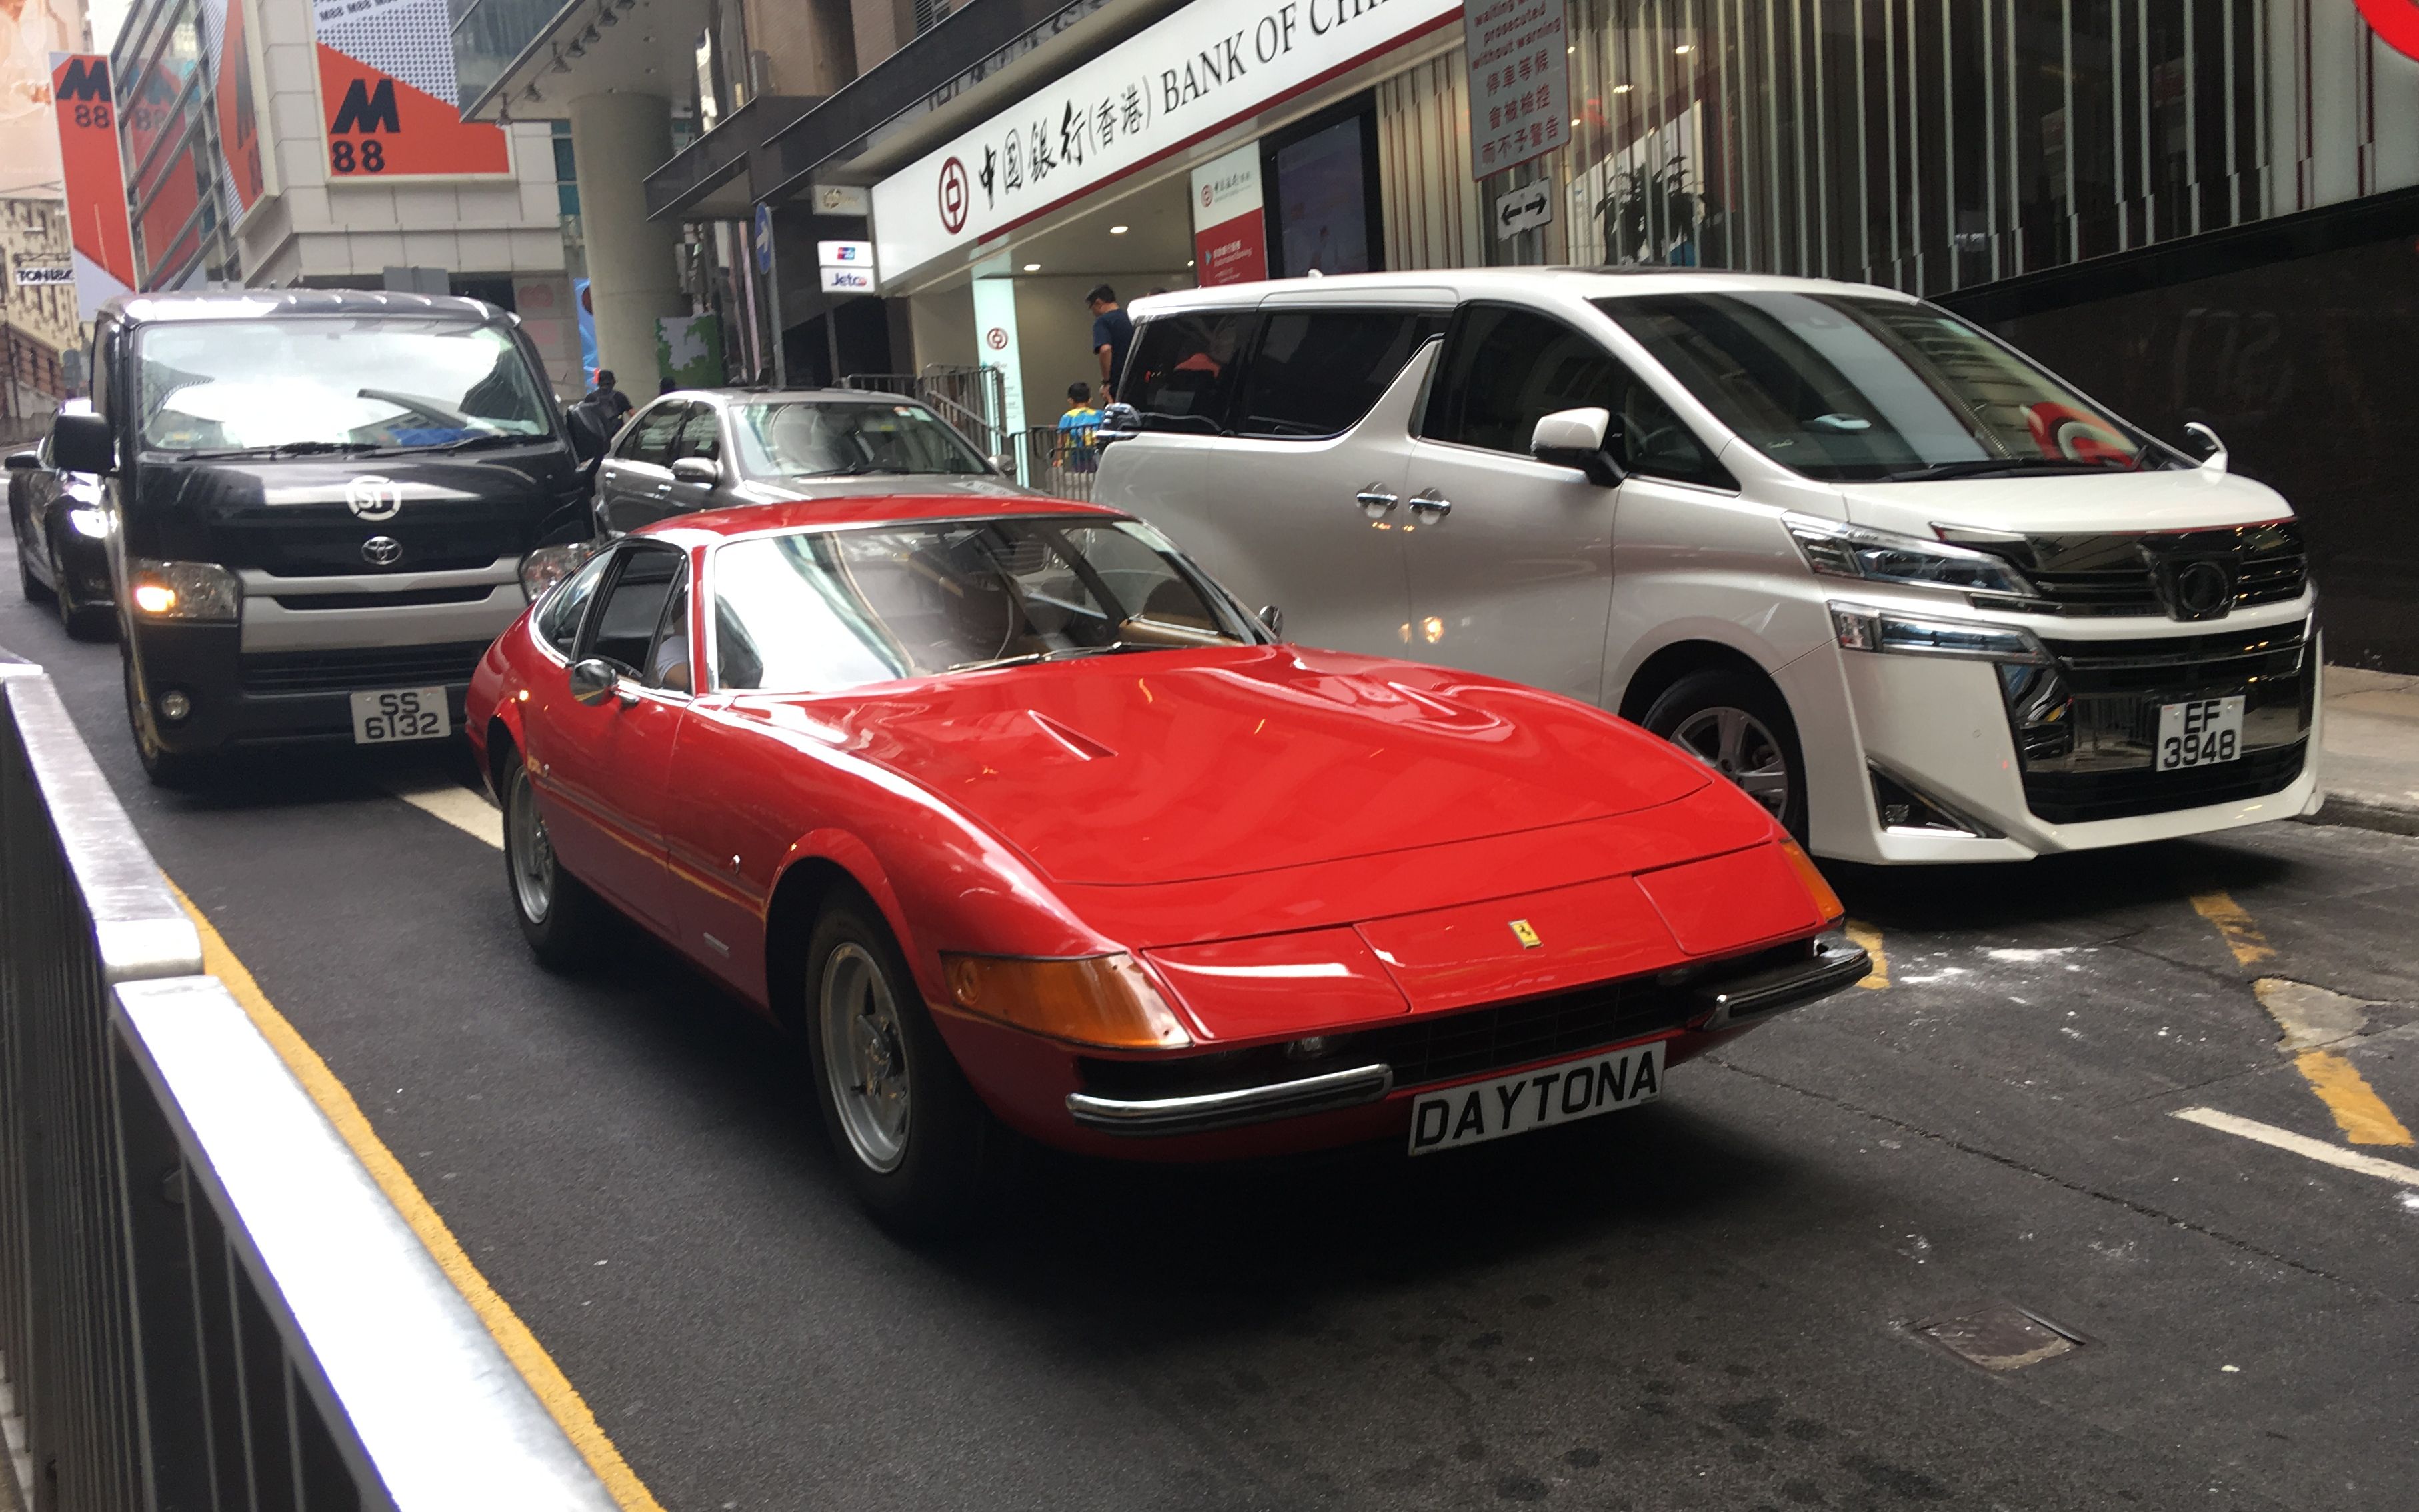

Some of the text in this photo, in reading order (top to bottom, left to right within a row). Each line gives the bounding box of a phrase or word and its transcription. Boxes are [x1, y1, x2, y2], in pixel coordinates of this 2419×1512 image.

[1472, 17, 1561, 69] without warning
[1484, 0, 1546, 47] prosecuted
[57, 59, 112, 101] M
[1159, 29, 1247, 115] BANK
[1255, 1, 1297, 64] OF
[1486, 48, 1549, 97] 停車等候
[75, 104, 110, 128] 88
[330, 79, 401, 134] M
[1489, 83, 1550, 131] 會被檢控
[332, 140, 385, 173] 88
[1482, 115, 1559, 164] 而不予警告
[831, 272, 867, 287] Jetco
[379, 692, 420, 715] SS
[2184, 699, 2221, 735] EF
[365, 713, 439, 739] 6132
[2164, 729, 2235, 768] 3948
[1415, 1051, 1657, 1148] DAYTONA
